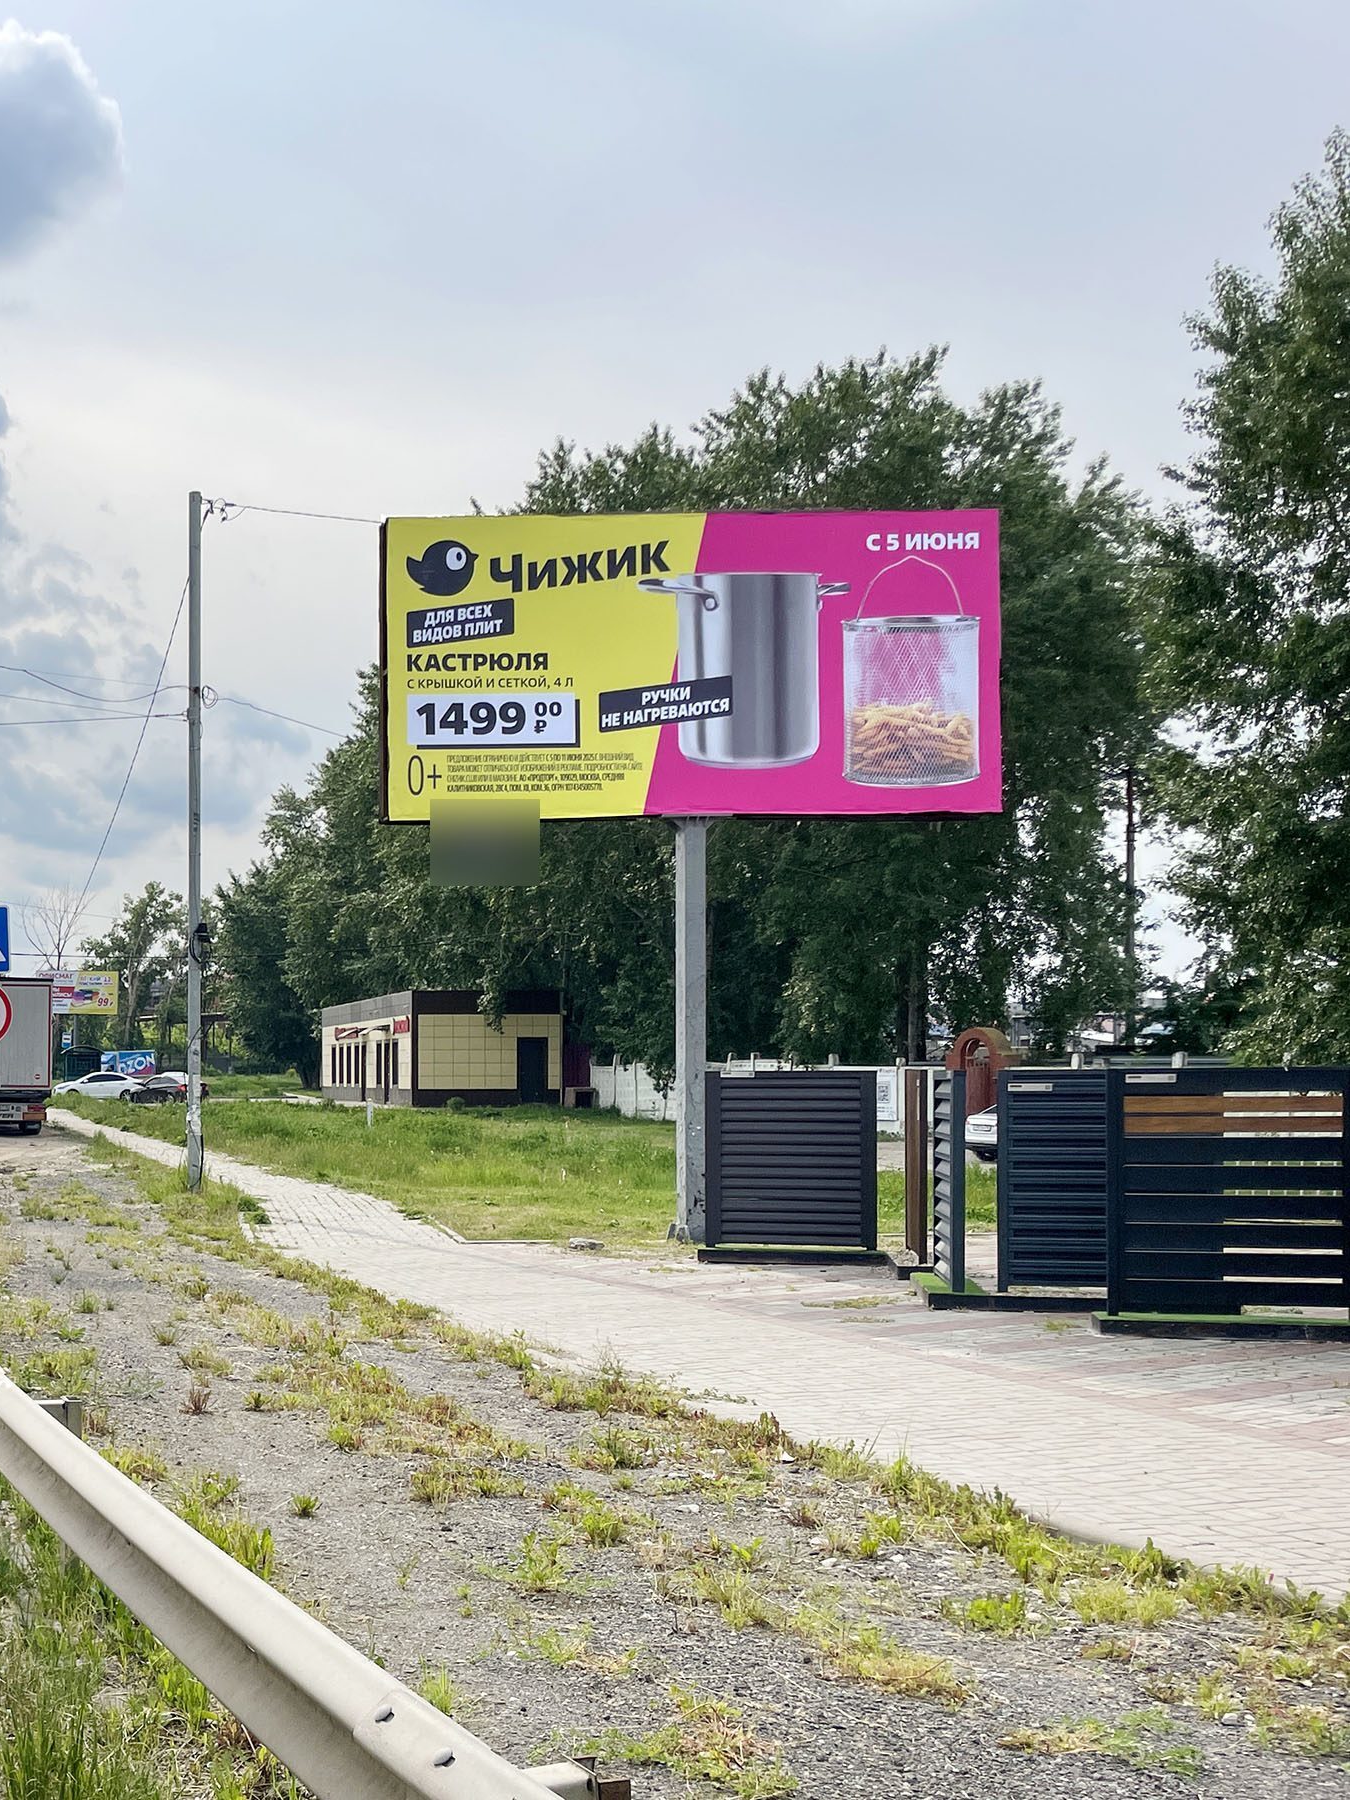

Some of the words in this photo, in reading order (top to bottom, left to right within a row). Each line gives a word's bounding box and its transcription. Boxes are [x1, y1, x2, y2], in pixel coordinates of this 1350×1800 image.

[865, 533, 881, 552] С
[886, 533, 900, 551] 5
[905, 532, 980, 551] ИЮНЯ
[424, 609, 455, 628] ДЛЯ
[457, 604, 493, 622] ВСЕХ
[412, 624, 462, 644] ВИДОВ
[464, 619, 503, 637] ПЛИТ
[406, 653, 549, 672] КАСТРЮЛЯ
[407, 678, 415, 689] С
[418, 676, 483, 689] КРЫШКОЙ
[486, 678, 495, 688] И
[498, 675, 551, 689] СЕТКОЙ,
[553, 677, 562, 687] 4
[564, 677, 573, 687] Л
[641, 686, 691, 706] РУЧКИ
[416, 701, 526, 735] 1499
[534, 701, 562, 717] 00
[601, 712, 621, 728] НЕ
[623, 697, 730, 725] НАГРЕВАЮТСЯ
[408, 755, 442, 795] 0+
